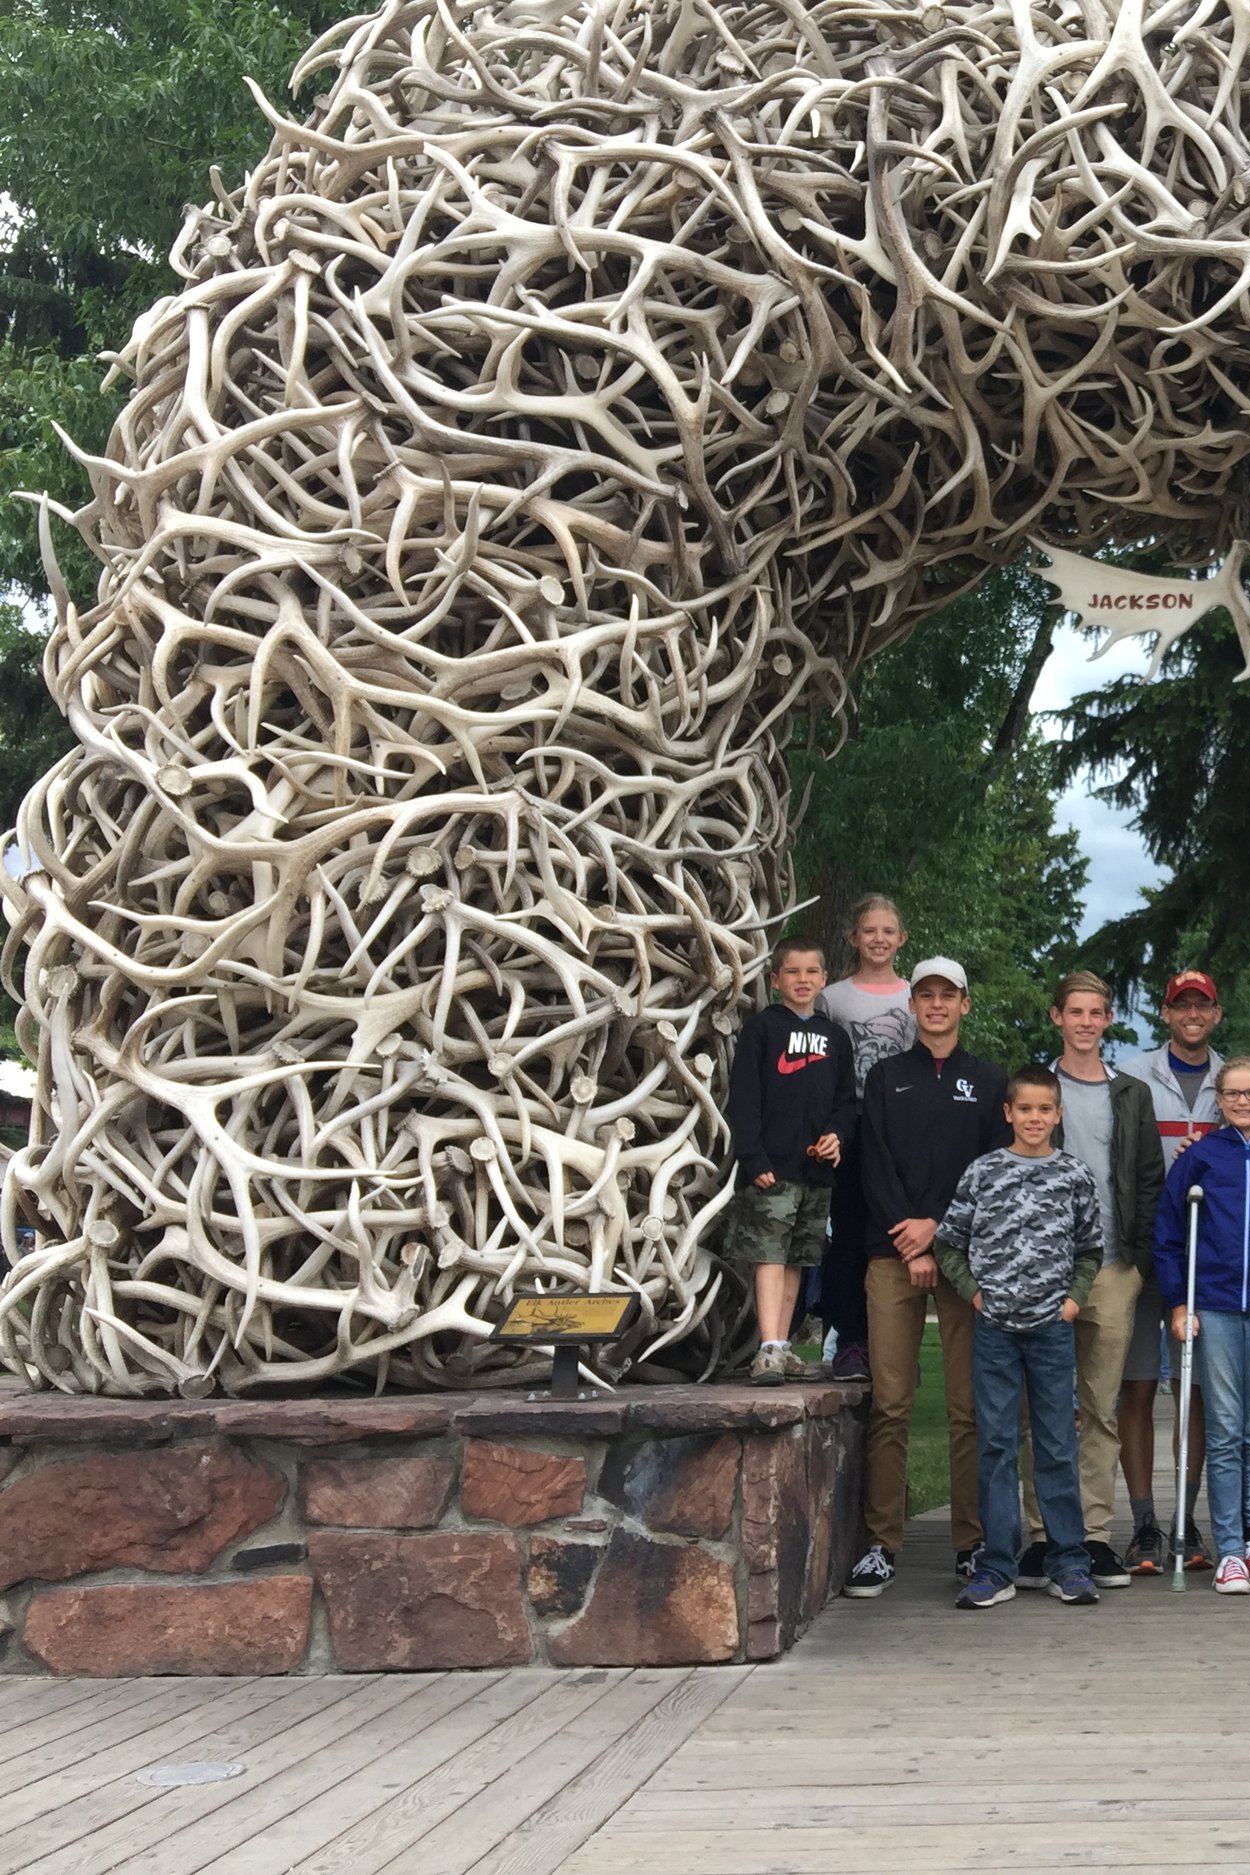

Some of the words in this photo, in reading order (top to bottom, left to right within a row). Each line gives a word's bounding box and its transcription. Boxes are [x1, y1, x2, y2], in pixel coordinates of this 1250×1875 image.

[1087, 593, 1194, 610] JACKSON
[788, 1031, 829, 1057] NIKE
[526, 1298, 542, 1307] Elk
[549, 1297, 582, 1307] Antler
[586, 1296, 621, 1306] Arches
